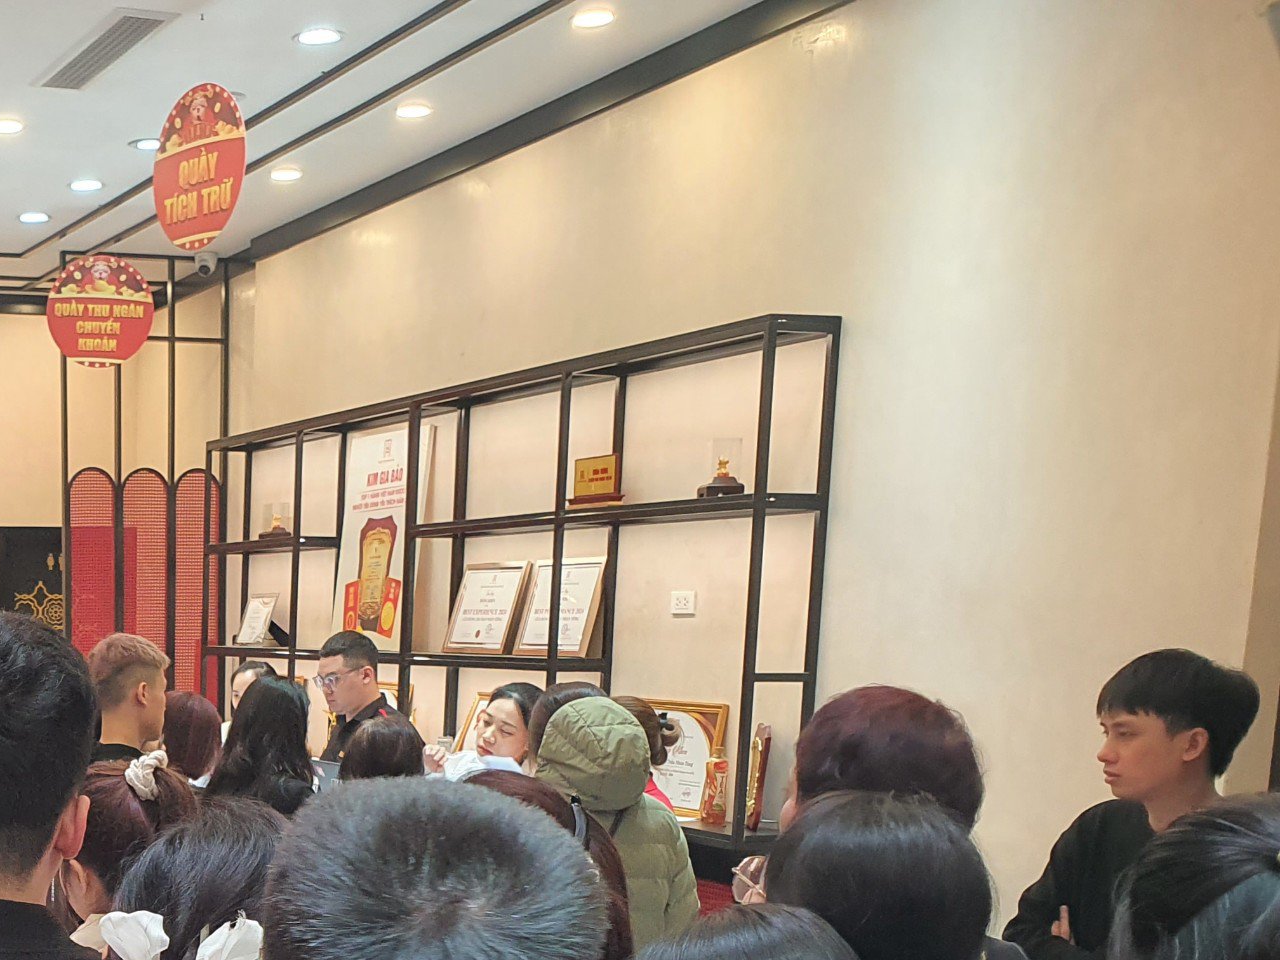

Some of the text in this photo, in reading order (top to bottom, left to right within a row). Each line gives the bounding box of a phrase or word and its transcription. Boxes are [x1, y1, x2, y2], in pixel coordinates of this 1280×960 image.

[179, 147, 218, 190] QUẦY
[164, 177, 234, 225] TÍCH TRỮ
[87, 303, 110, 317] THU
[113, 302, 144, 318] NGÂN
